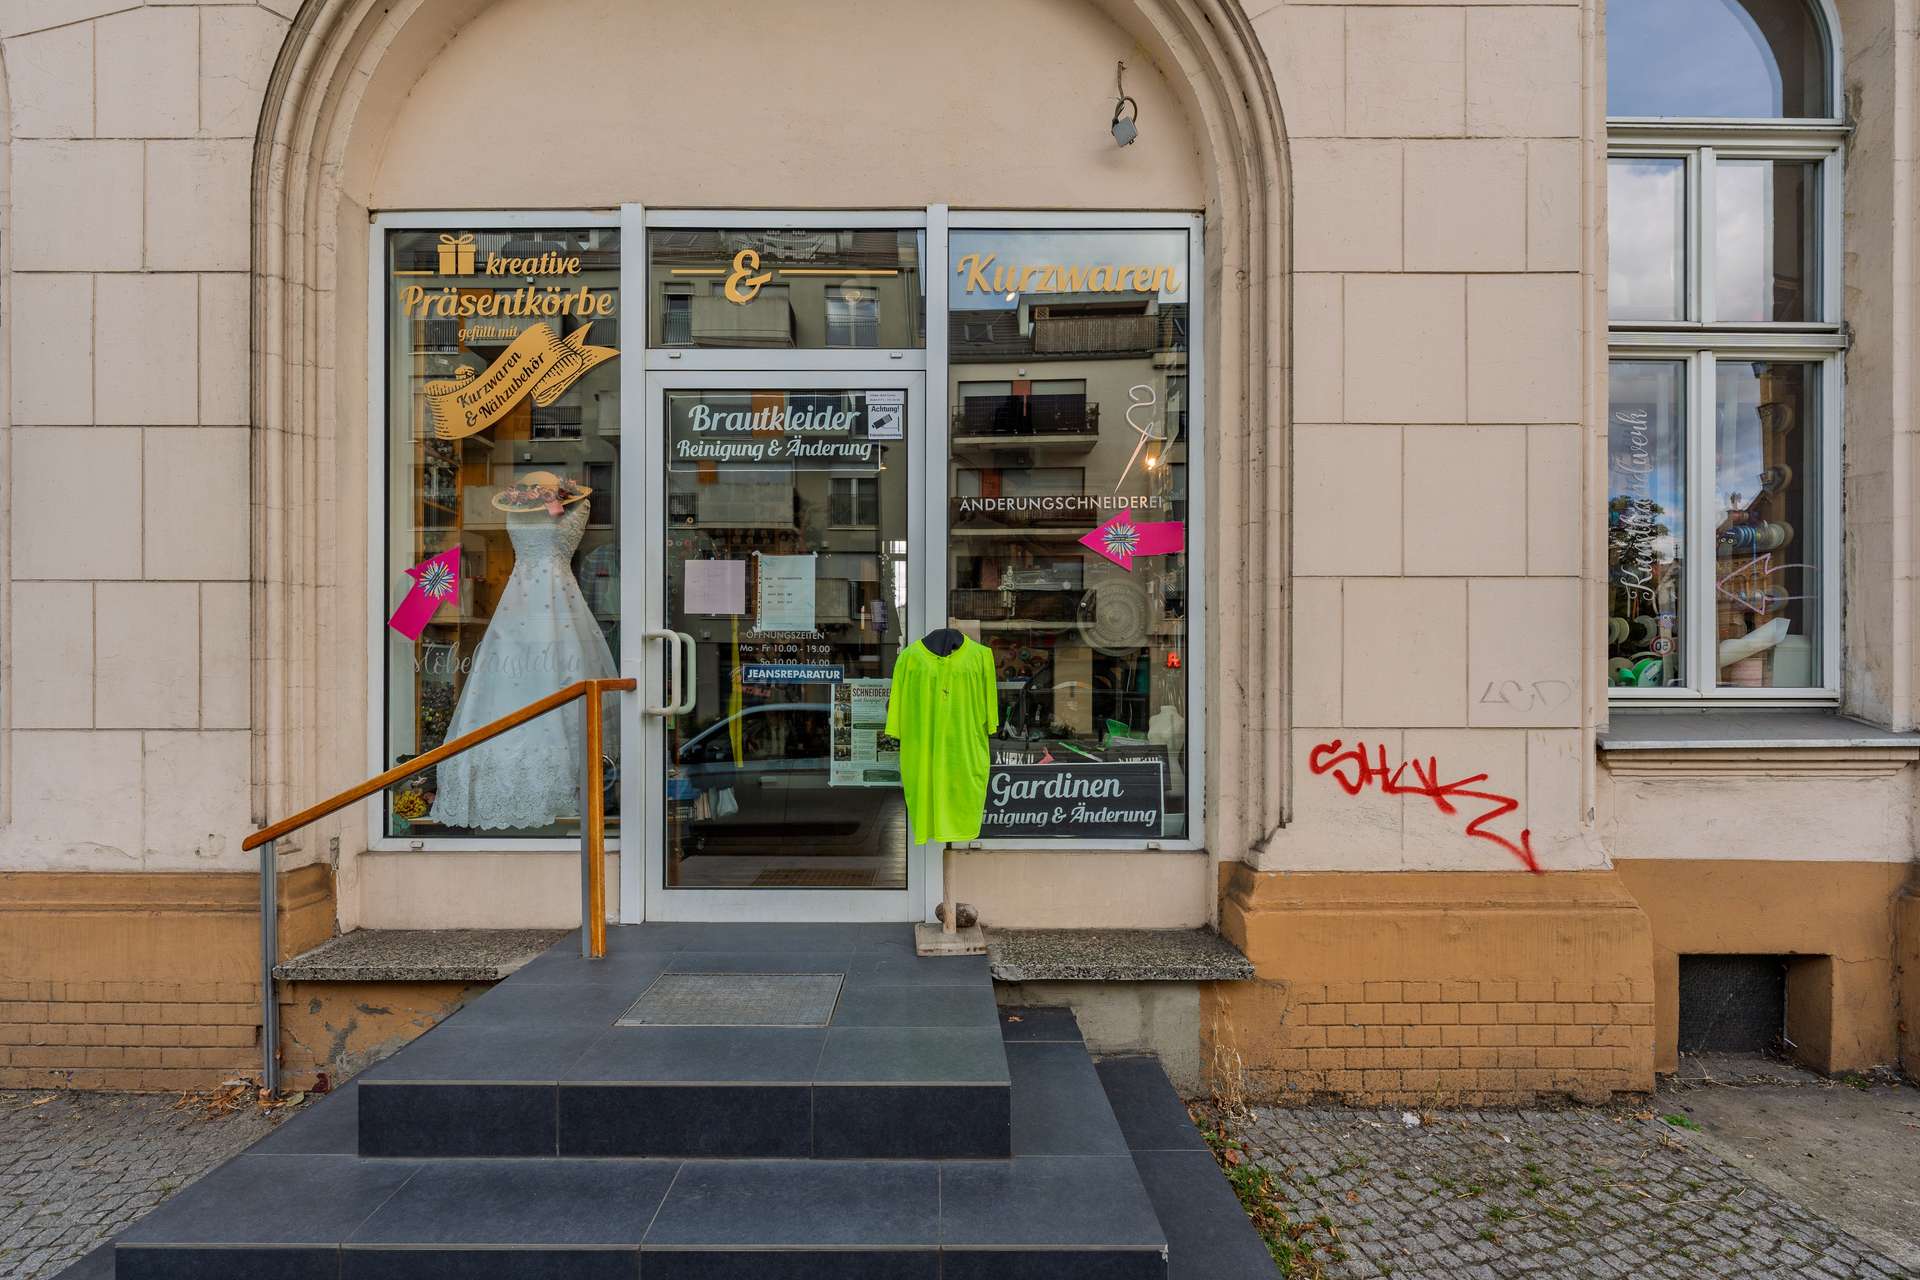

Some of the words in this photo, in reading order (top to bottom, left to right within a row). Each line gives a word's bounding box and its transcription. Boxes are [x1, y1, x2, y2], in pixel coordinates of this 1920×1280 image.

[486, 251, 581, 276] kreative
[724, 249, 772, 304] &
[957, 253, 1182, 293] Kurzwaren
[400, 285, 616, 317] Präsentkörbe
[458, 325, 498, 341] gefüllt
[498, 326, 520, 338] mit
[457, 350, 523, 409] Kurzwaren
[464, 410, 478, 427] &
[478, 352, 546, 419] Nähzubehör
[688, 404, 860, 432] Brautkleider
[677, 438, 764, 461] Reinigung
[768, 438, 782, 458] &
[786, 435, 872, 461] Änderung
[960, 495, 1163, 513] ÄNDERUNGSCHNEIDEREI
[739, 643, 753, 652] Mo
[761, 644, 770, 652] Fr
[747, 669, 840, 679] JEANSREPARATUR
[991, 773, 1124, 807] Gardinen
[983, 809, 1048, 828] inigung
[1052, 807, 1067, 823] &
[1070, 802, 1156, 827] Änderung
